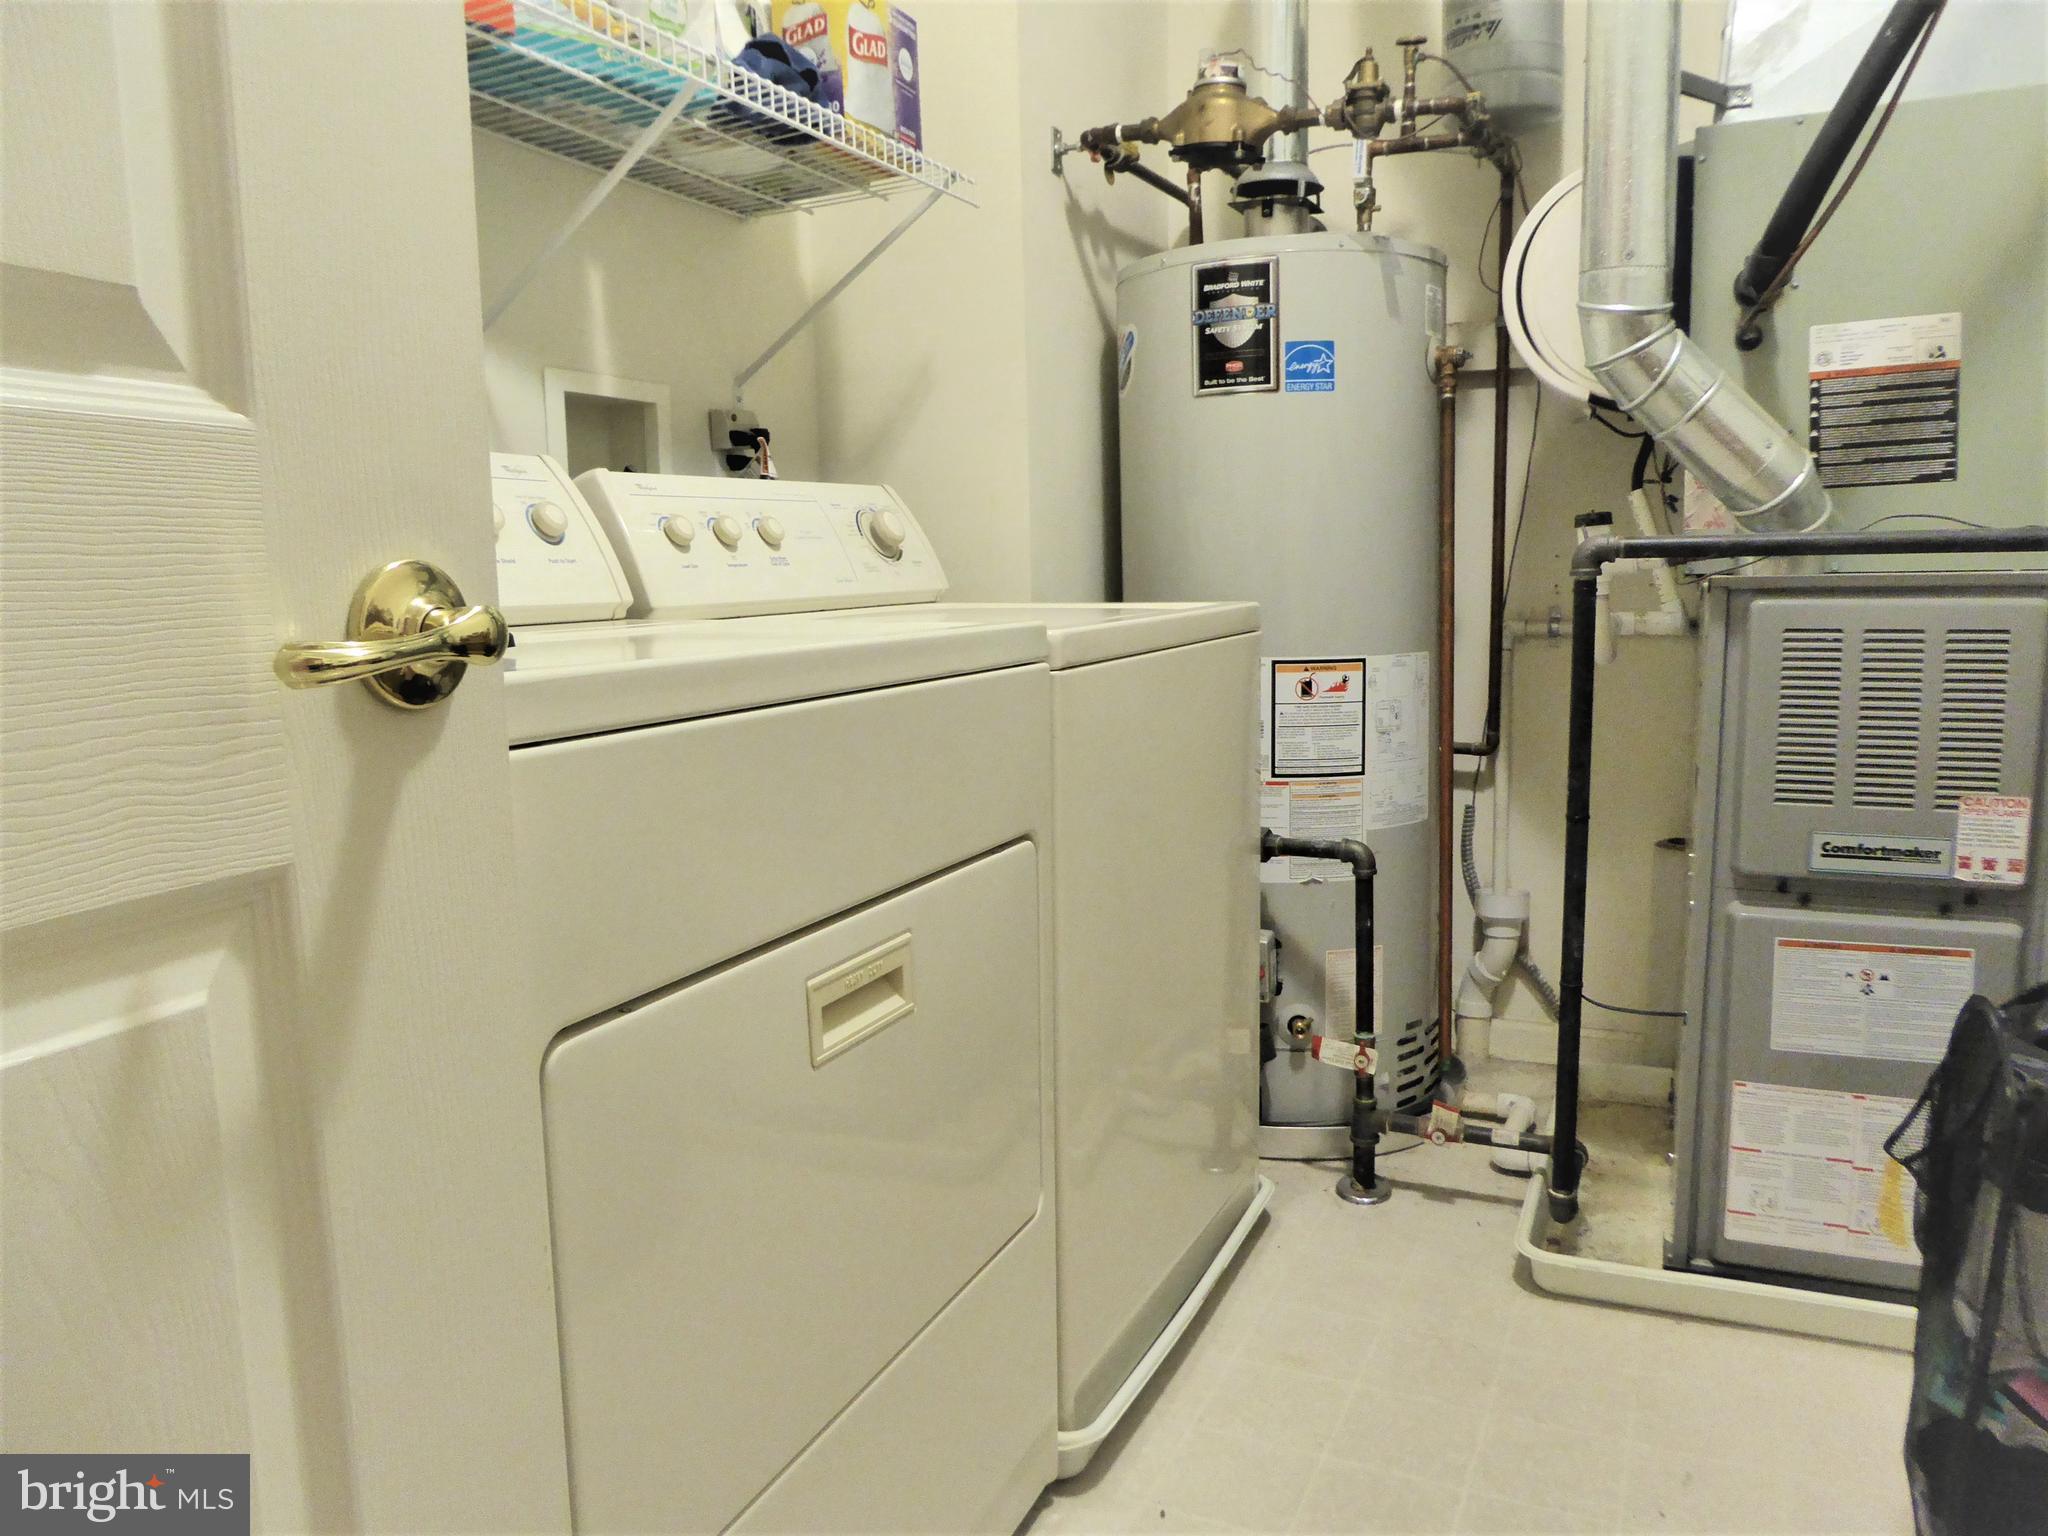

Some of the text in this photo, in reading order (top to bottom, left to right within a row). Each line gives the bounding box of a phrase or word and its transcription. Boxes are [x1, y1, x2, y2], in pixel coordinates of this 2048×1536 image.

[785, 17, 826, 45] GLAD
[852, 33, 887, 58] GLAD
[1203, 281, 1240, 292] BRADFORD
[1241, 279, 1265, 288] WHITE
[1193, 304, 1277, 325] DEFENDER
[1286, 382, 1333, 392] ENERGY STAR
[1962, 796, 2029, 810] CAUTION
[1820, 841, 1942, 859] Comfortmaker
